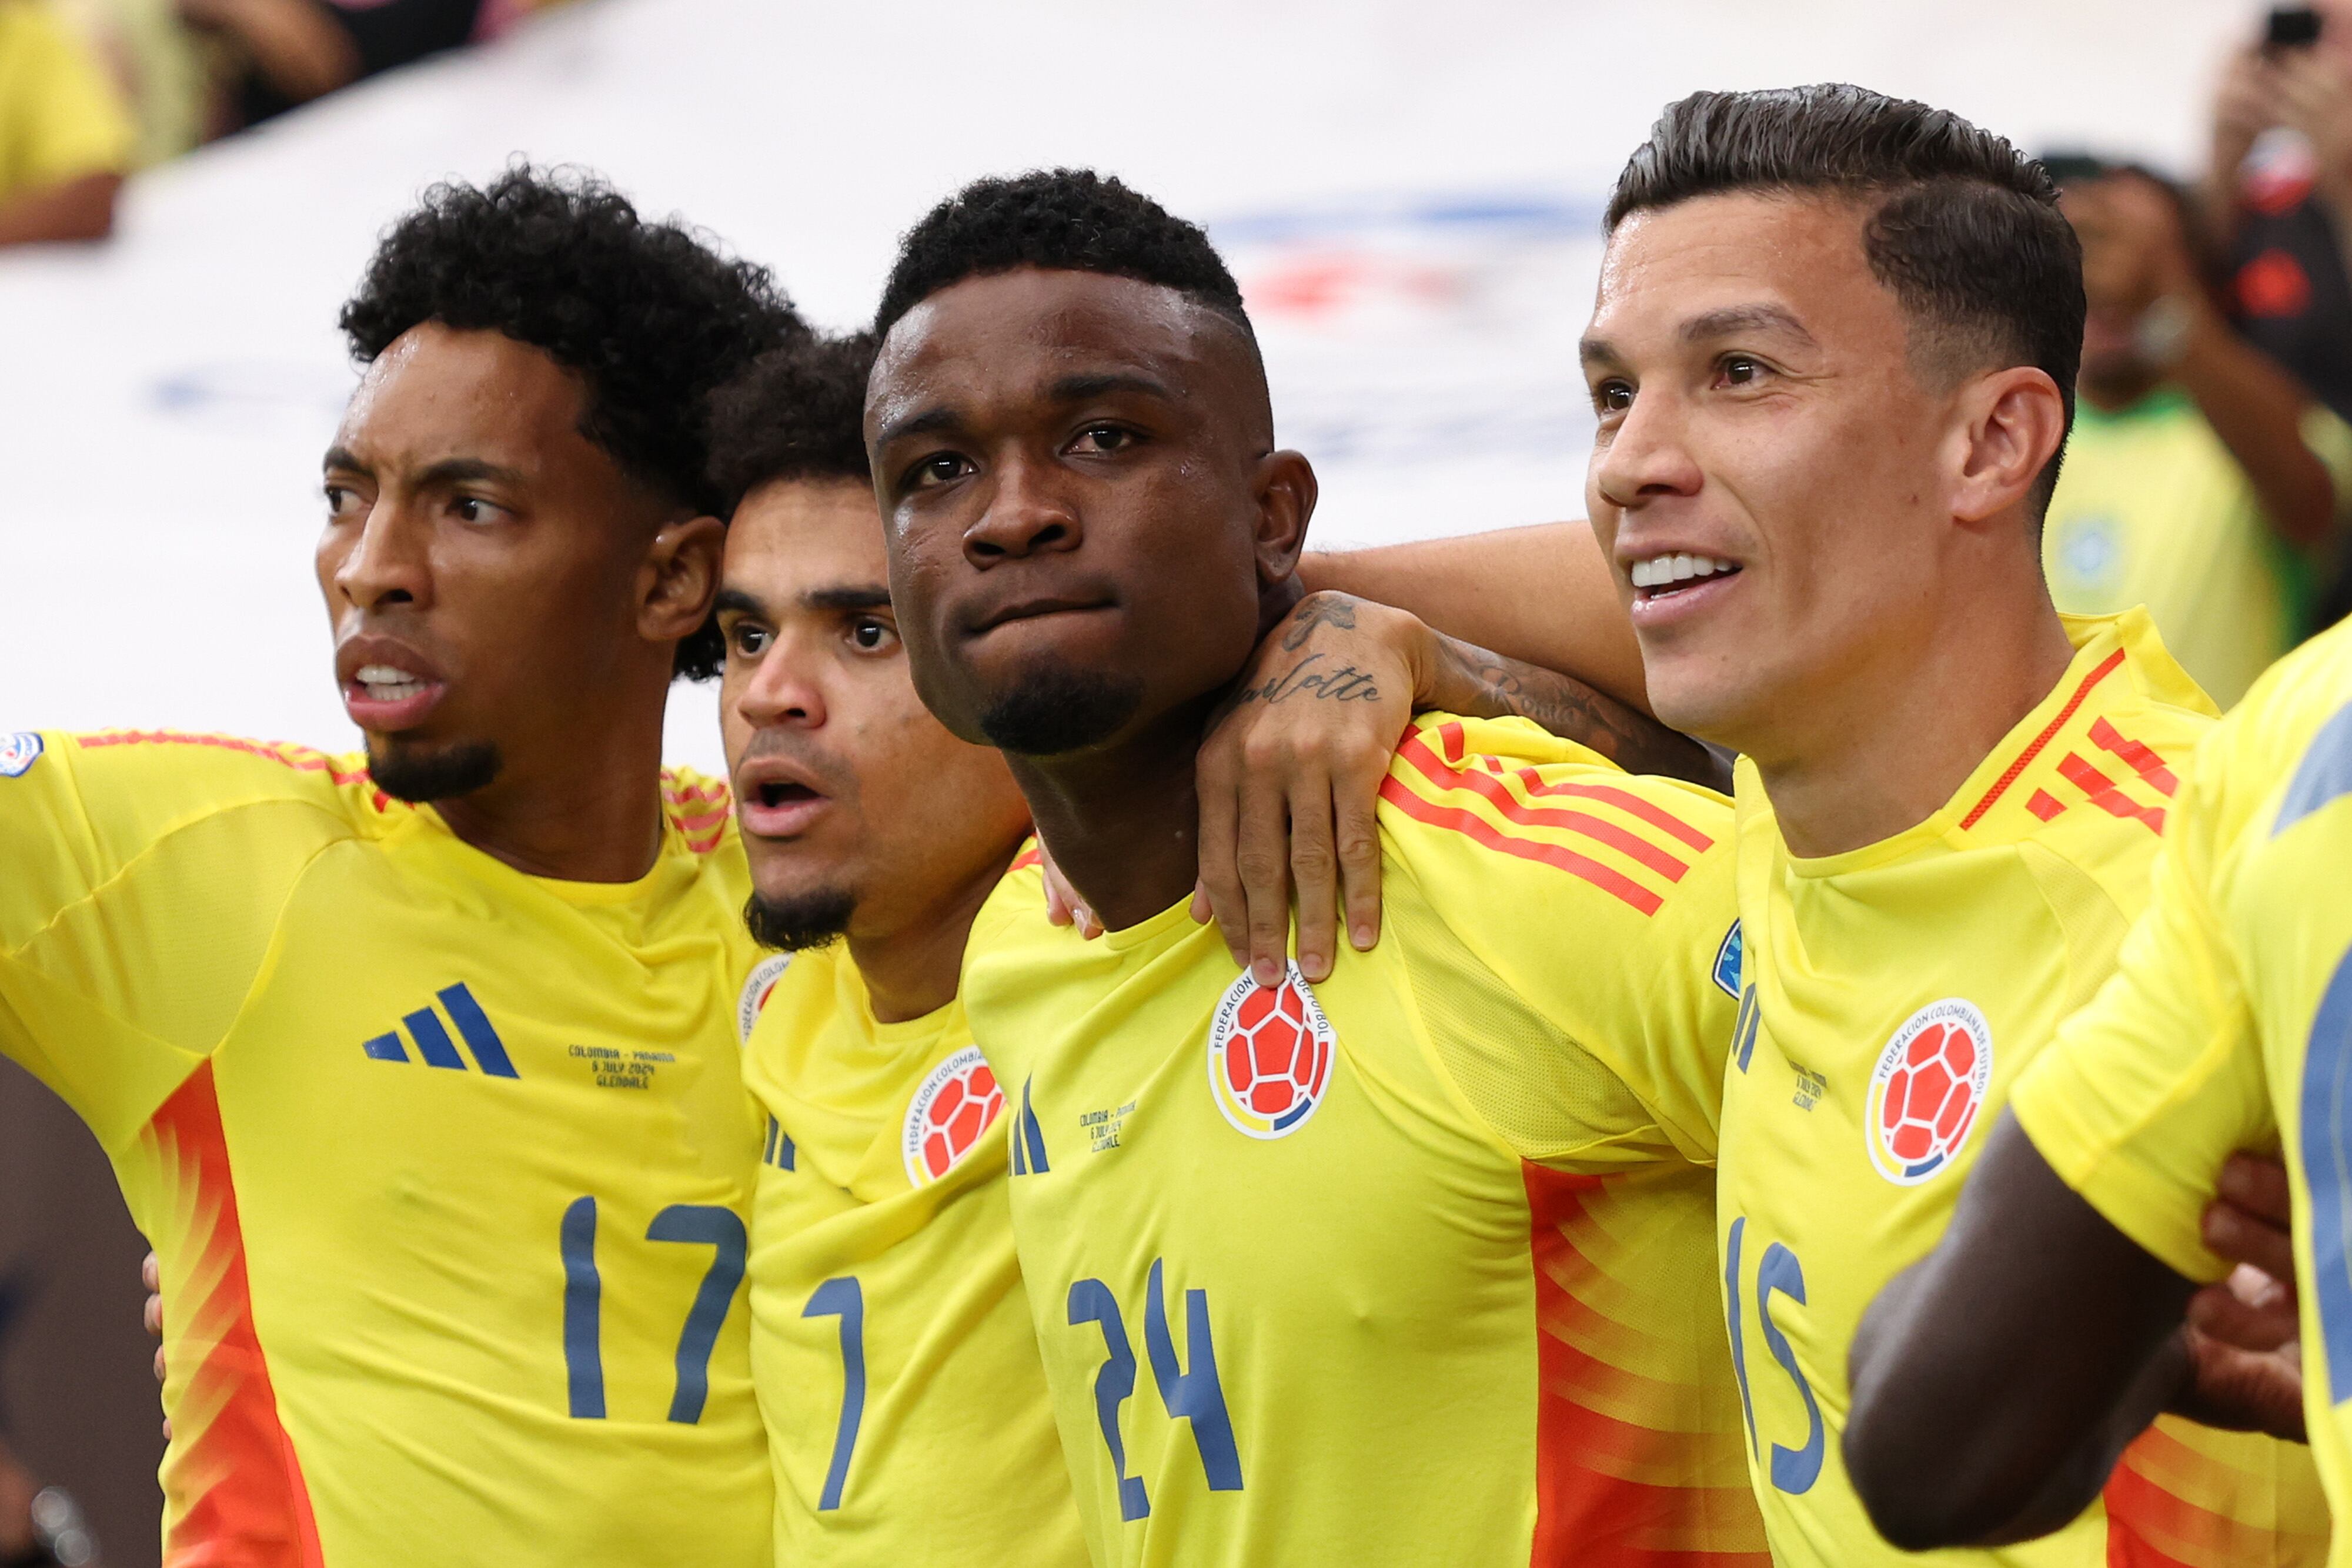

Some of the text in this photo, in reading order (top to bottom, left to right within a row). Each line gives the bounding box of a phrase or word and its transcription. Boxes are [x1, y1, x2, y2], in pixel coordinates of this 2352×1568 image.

[1238, 653, 1382, 704] arlotte
[1215, 976, 1253, 1048] FEDERACION
[1879, 1012, 1929, 1078] FEDERACION
[1930, 1005, 1980, 1034] COLOMBIANA
[1976, 1031, 1986, 1048] DE
[569, 1045, 620, 1059] COLOMBIA
[592, 1061, 654, 1075] 6 JULY 2024
[597, 1075, 648, 1089] GLENDALE
[909, 1080, 937, 1152] FEDERACION
[560, 1196, 747, 1425] 17
[801, 1276, 865, 1511] 7
[1067, 1257, 1244, 1522] 24
